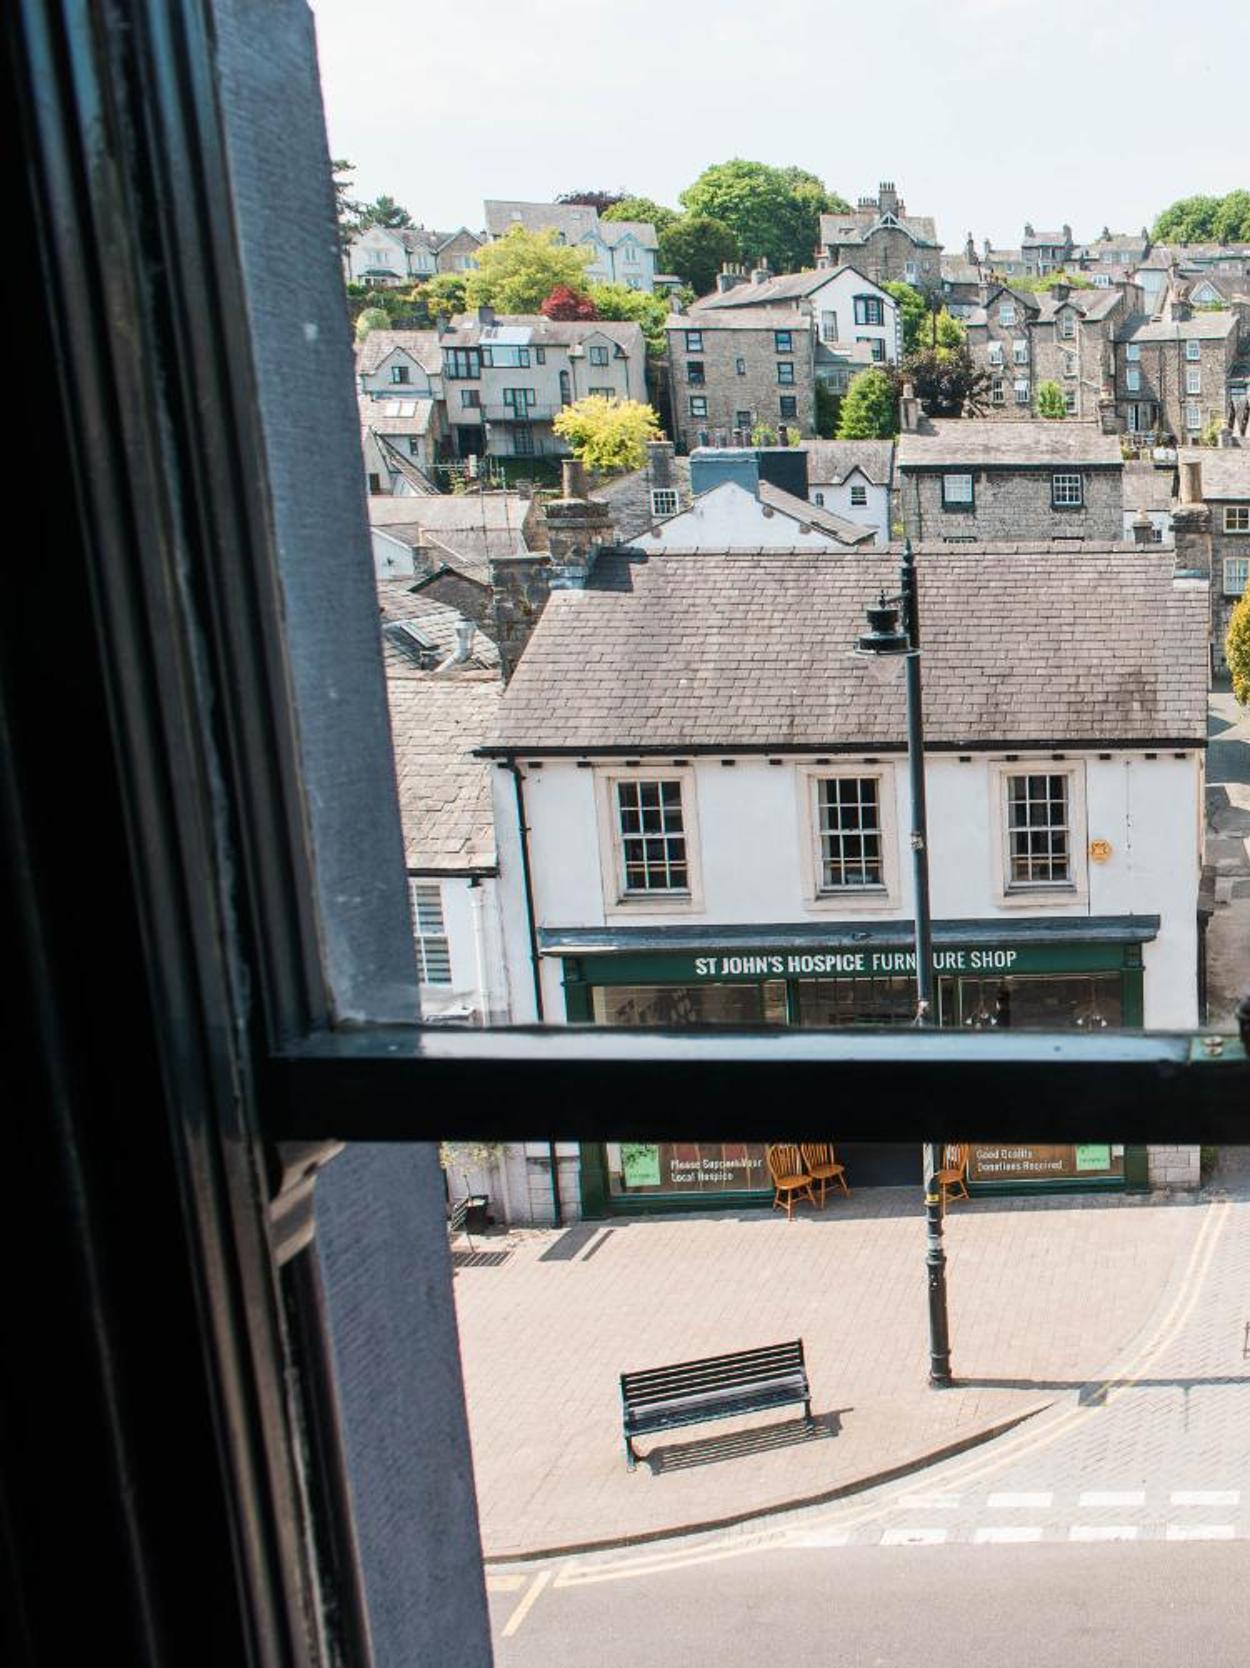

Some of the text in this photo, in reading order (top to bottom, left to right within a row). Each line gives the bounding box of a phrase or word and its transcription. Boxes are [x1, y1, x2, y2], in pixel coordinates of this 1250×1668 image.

[695, 950, 1017, 976] ST JOHN'S HOSPICE FURNURE SHOP
